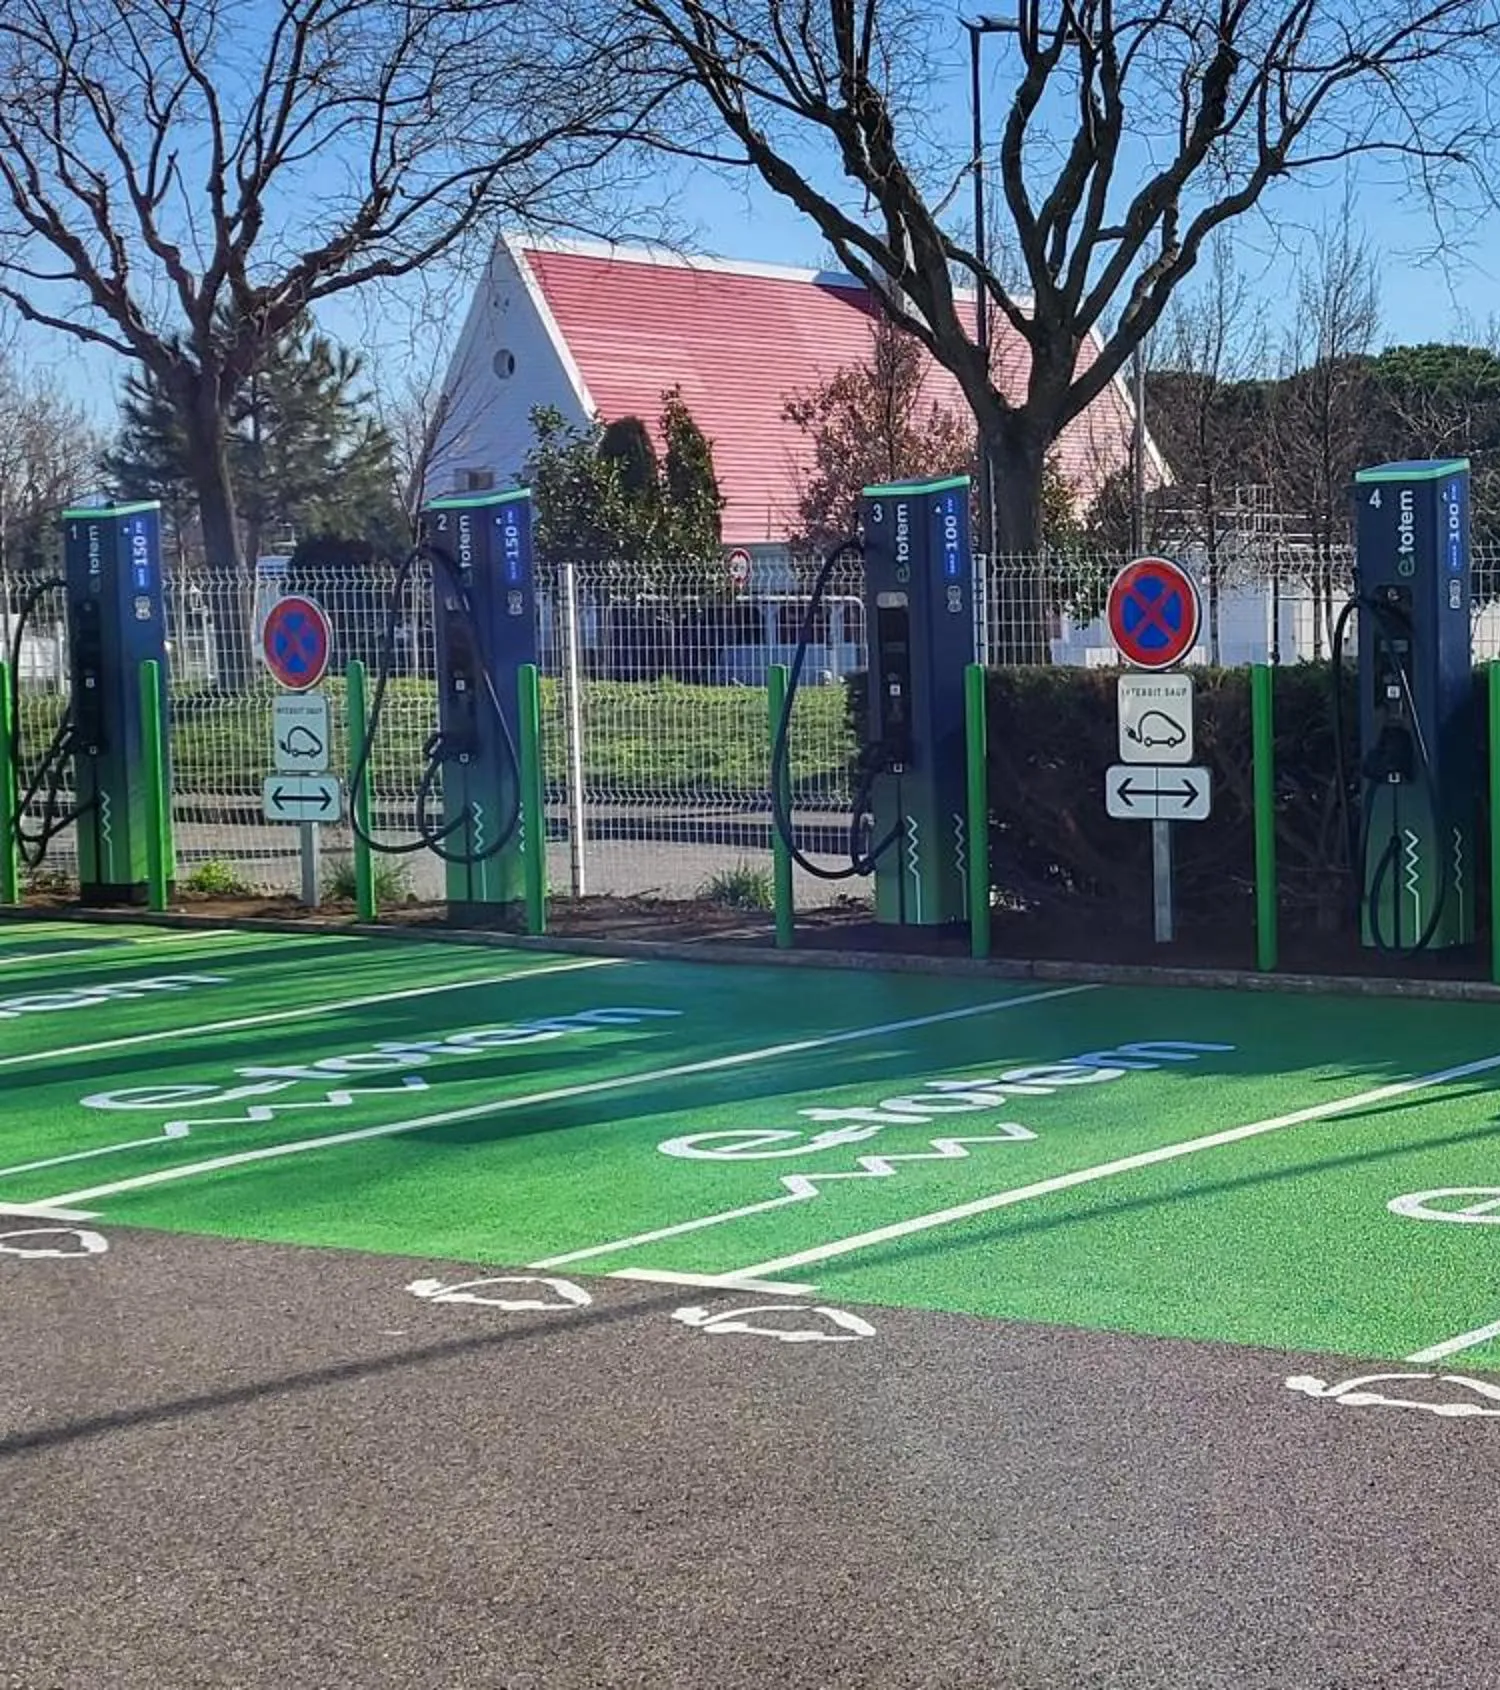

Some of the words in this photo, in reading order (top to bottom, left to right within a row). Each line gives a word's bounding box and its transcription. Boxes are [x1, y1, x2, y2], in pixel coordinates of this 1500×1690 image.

[1369, 487, 1382, 509] 4
[437, 513, 448, 531] 2
[872, 503, 883, 523] 3
[1448, 503, 1460, 543] 100
[70, 524, 78, 540] 1
[505, 525, 519, 559] 150
[944, 515, 959, 551] 100
[132, 535, 149, 566] 150
